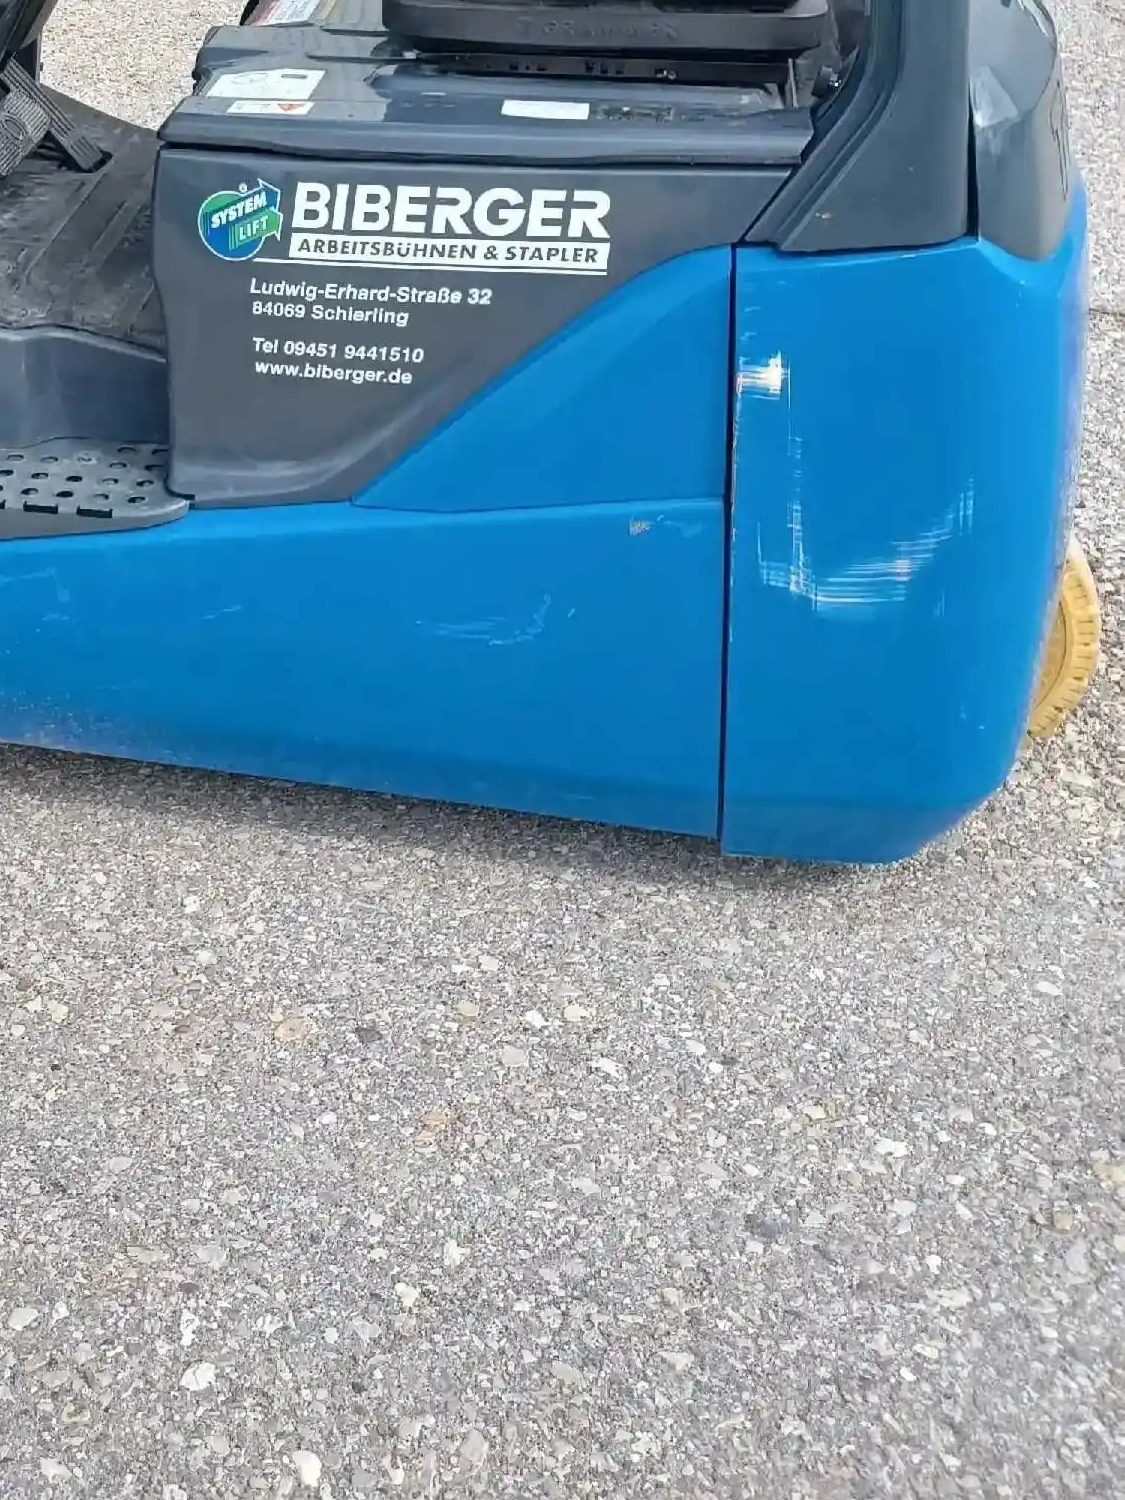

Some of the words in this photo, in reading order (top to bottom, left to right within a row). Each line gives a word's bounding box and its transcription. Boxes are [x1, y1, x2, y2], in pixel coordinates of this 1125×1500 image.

[211, 191, 268, 229] SYSTEM
[291, 182, 611, 239] BIBERGER
[239, 215, 269, 241] LIFT
[297, 238, 476, 260] ARBEITSBÜHNEN
[483, 243, 500, 261] &
[505, 244, 599, 263] STAPLER
[250, 277, 463, 304] Ludwig-Erhard-Straße
[467, 288, 493, 305] 32
[252, 301, 306, 318] 84069
[311, 305, 410, 327] Schierling
[252, 337, 278, 353] Tel
[283, 340, 337, 358] 09451
[344, 344, 425, 363] 9441510
[255, 360, 414, 385] www.biberger.de
